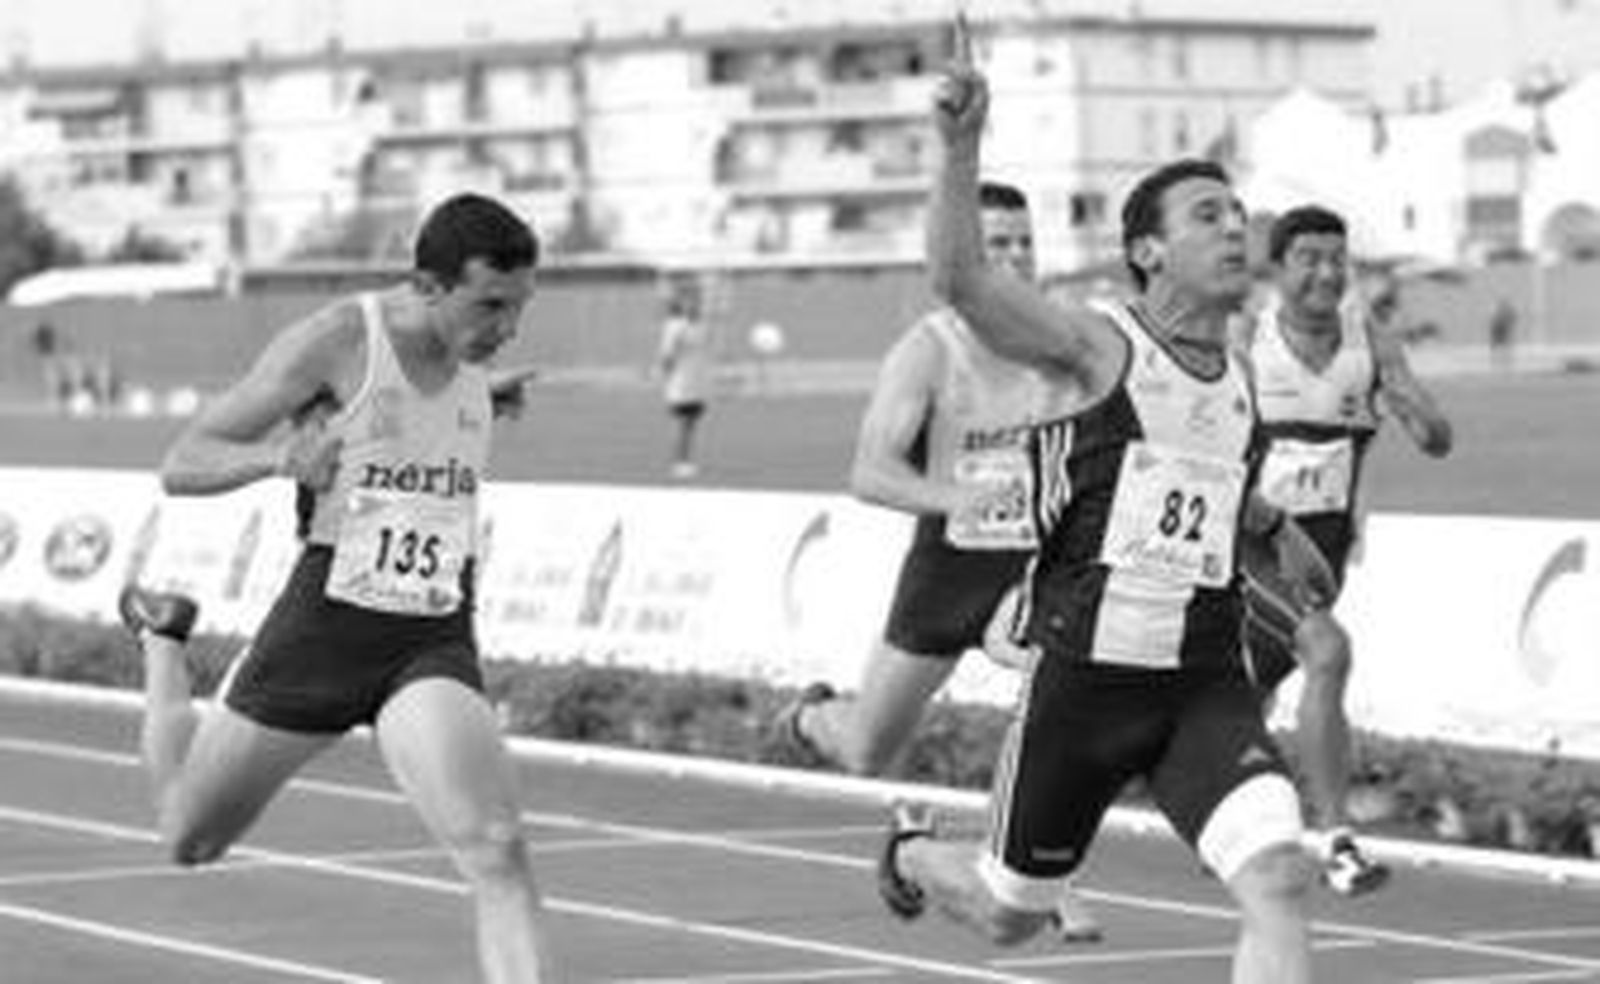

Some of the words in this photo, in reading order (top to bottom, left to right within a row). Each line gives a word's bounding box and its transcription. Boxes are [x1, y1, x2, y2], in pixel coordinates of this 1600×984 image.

[358, 458, 477, 498] nerja
[1158, 489, 1207, 542] 82
[376, 527, 440, 579] 135
